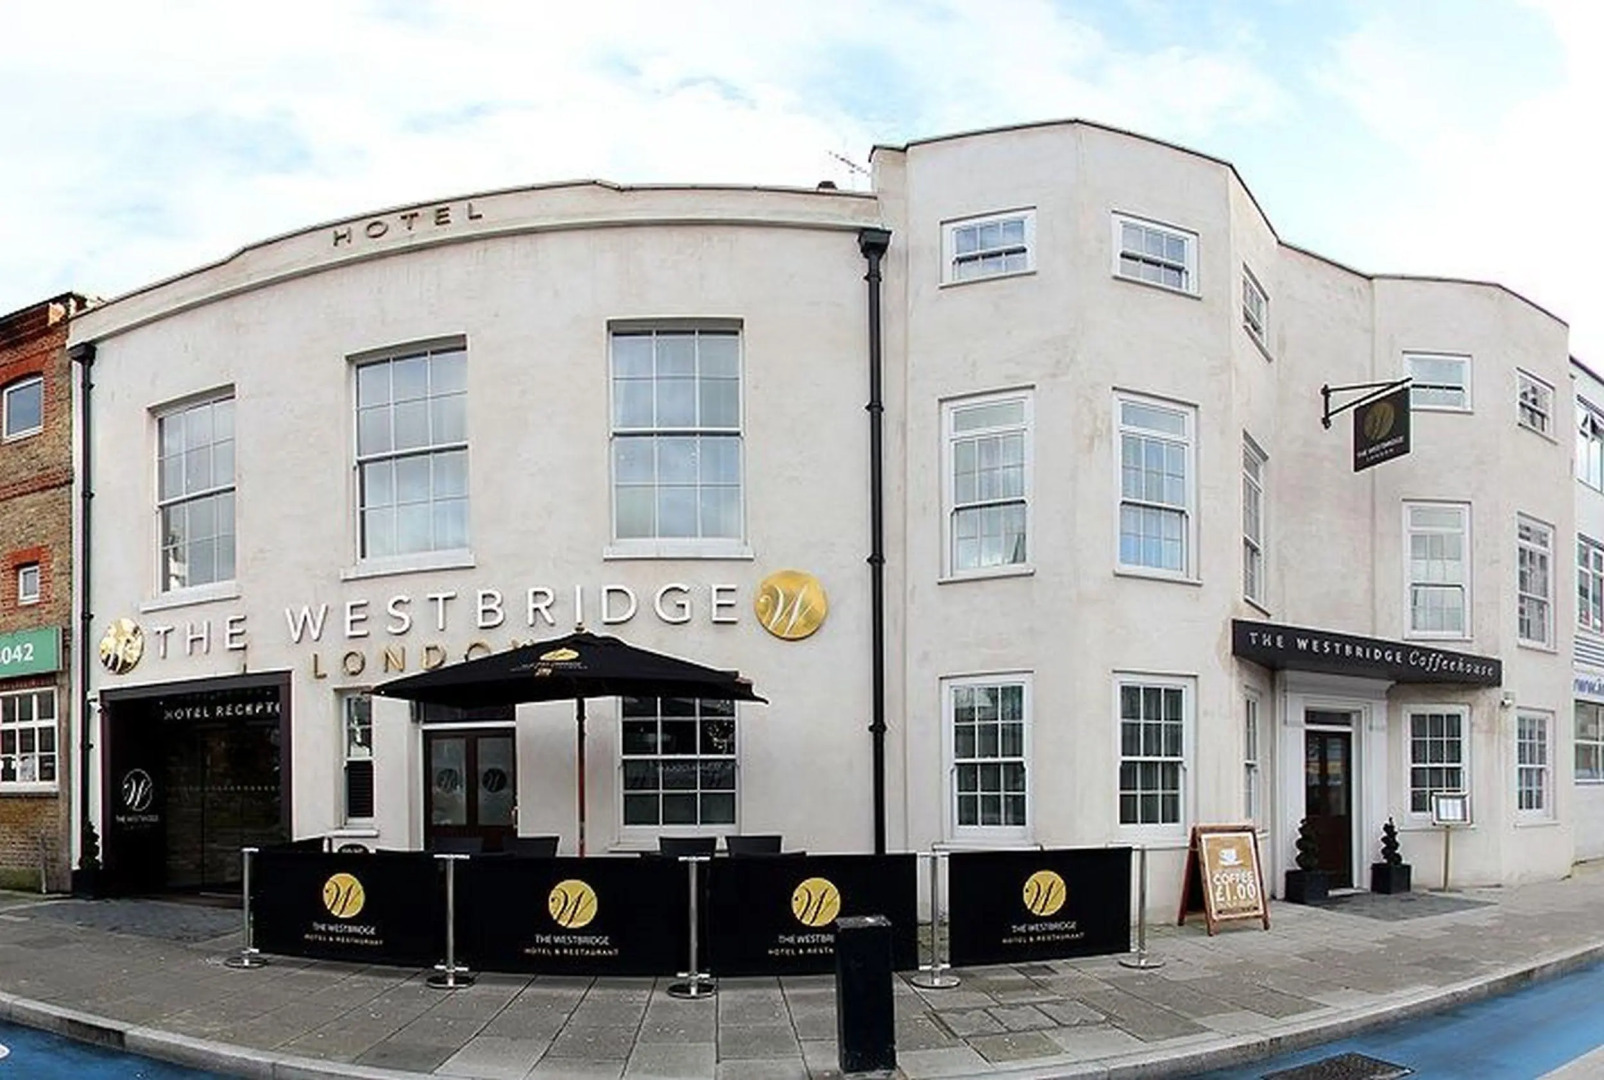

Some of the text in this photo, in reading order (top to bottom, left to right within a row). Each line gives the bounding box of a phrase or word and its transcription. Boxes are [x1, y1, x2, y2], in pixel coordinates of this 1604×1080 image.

[332, 201, 483, 247] HOTEL
[154, 614, 248, 660] THE
[284, 582, 740, 644] WESTBRIDGE
[0, 642, 35, 665] 042
[312, 637, 537, 680] LONDO
[1249, 631, 1496, 678] THE WESTBRIDGE Coffeehouse
[164, 705, 210, 720] HOTEL
[1212, 870, 1255, 886] COFFEE
[1215, 881, 1257, 902] £1.00
[535, 933, 610, 946] THE WESTBRIDGE
[778, 933, 796, 944] THE
